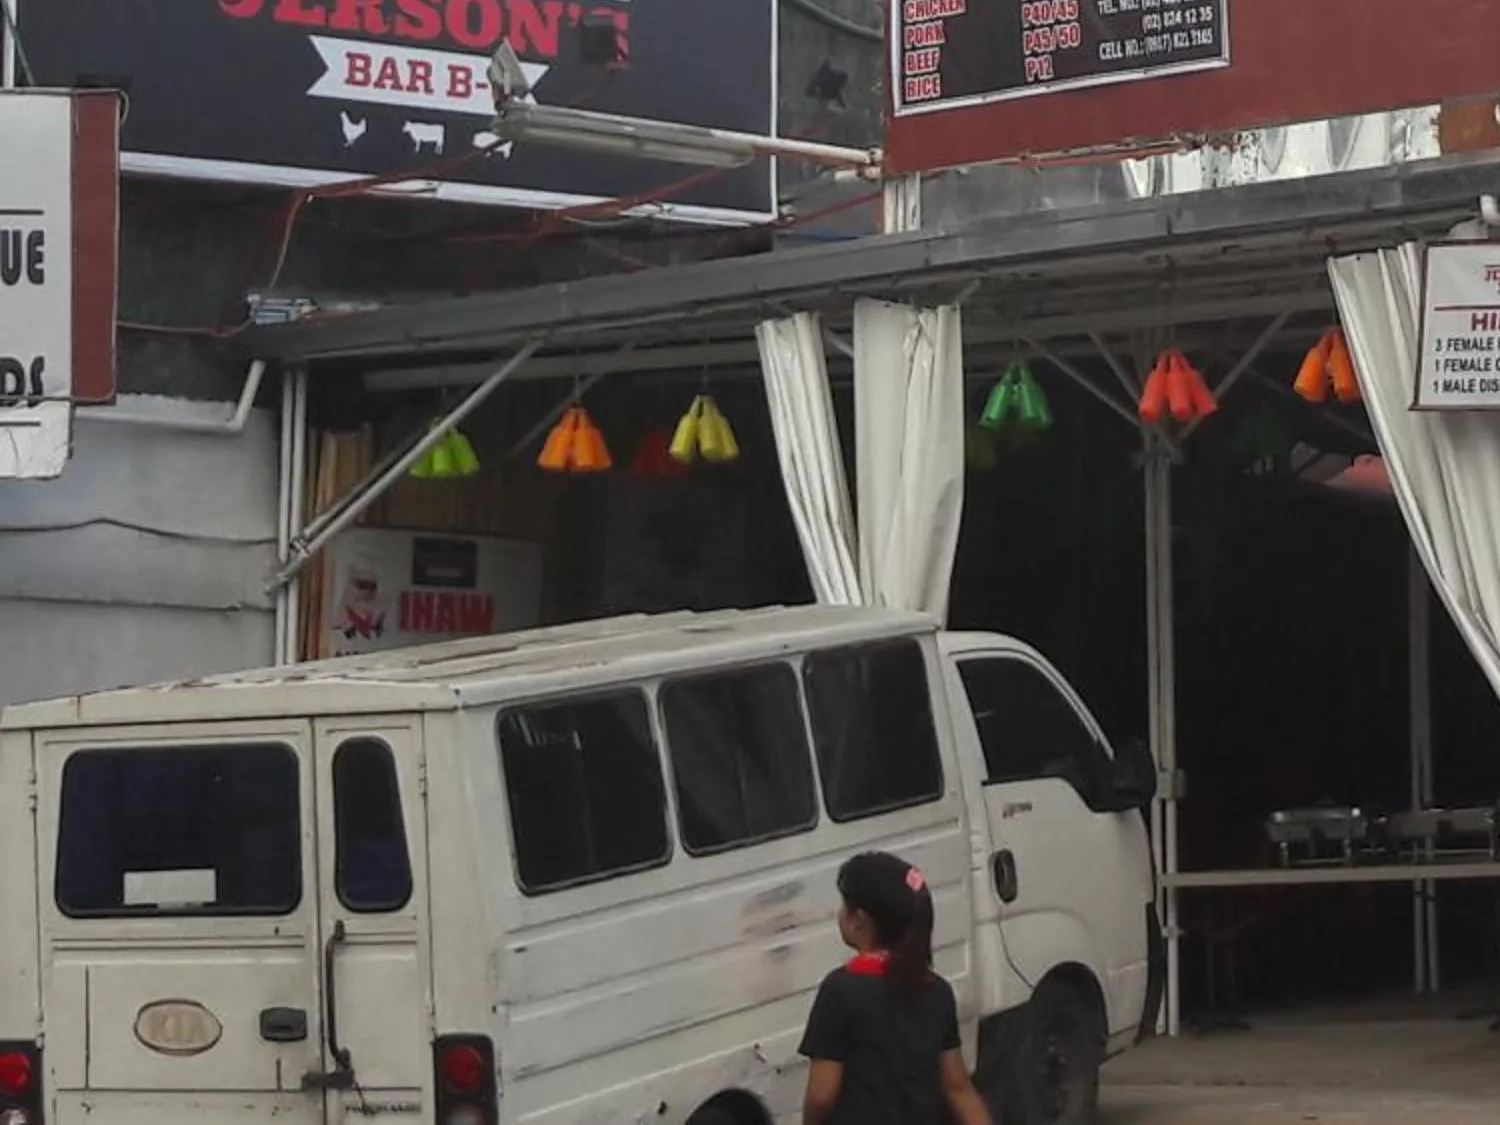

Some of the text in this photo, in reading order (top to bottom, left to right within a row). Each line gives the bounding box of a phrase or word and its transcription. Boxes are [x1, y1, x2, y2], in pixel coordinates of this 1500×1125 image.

[1199, 6, 1213, 22] 35
[905, 20, 946, 49] PORK
[1023, 22, 1081, 56] P45/50
[906, 47, 941, 75] BEEF
[1099, 41, 1123, 61] CELL
[344, 52, 434, 95] BAR
[906, 73, 941, 102] RICE
[1446, 337, 1495, 352] FEMALE
[1443, 357, 1493, 373] FEMALE
[1441, 378, 1478, 393] MALE
